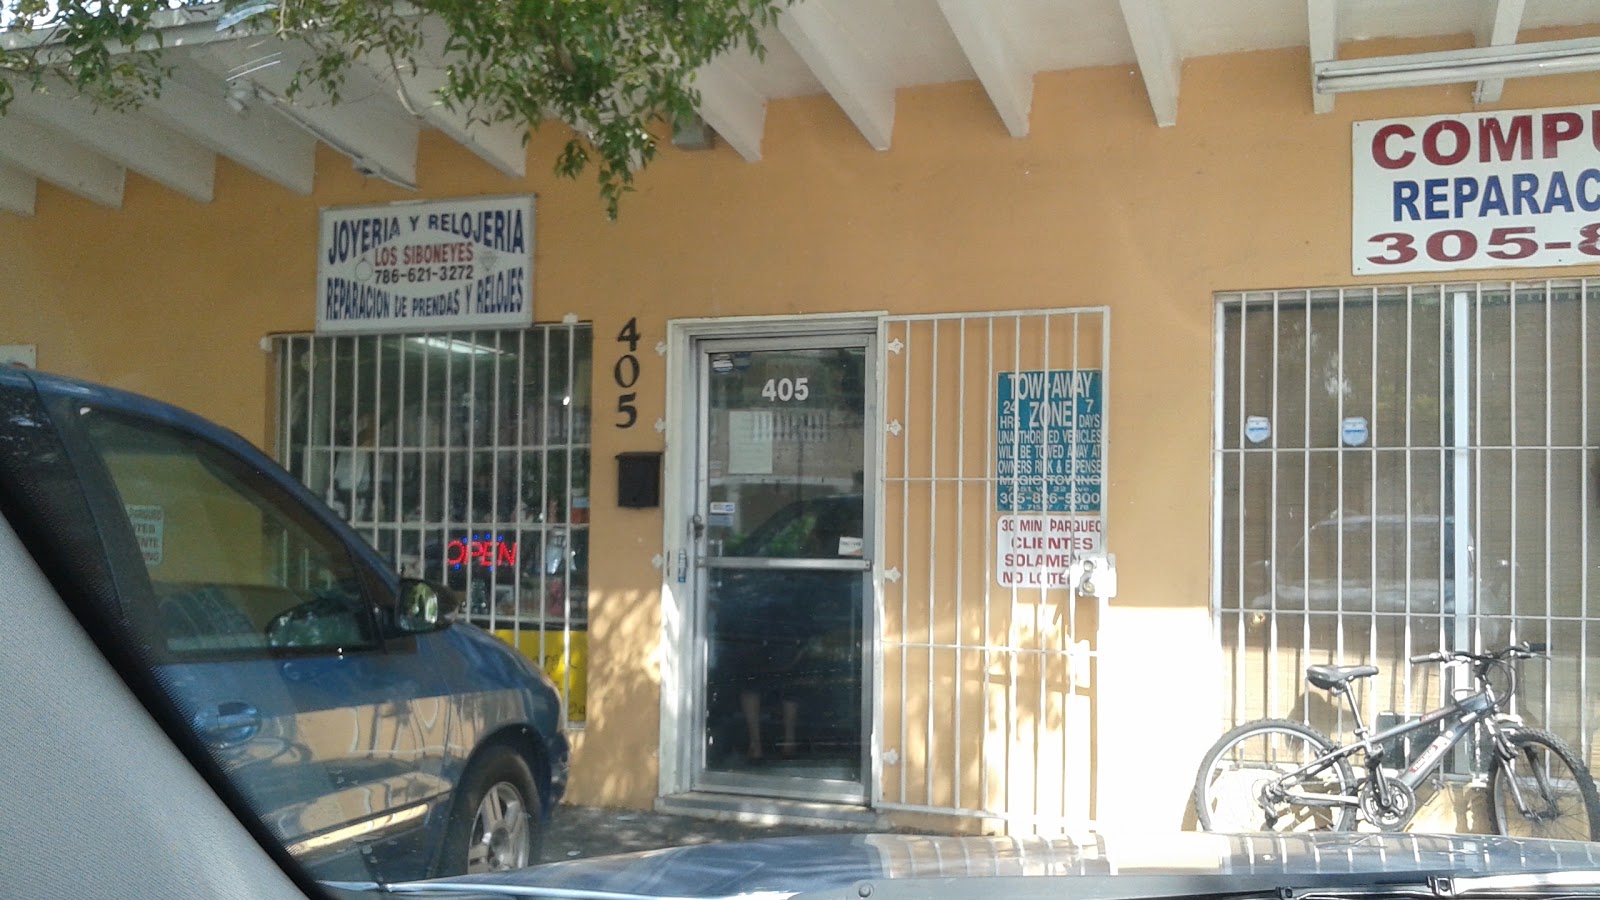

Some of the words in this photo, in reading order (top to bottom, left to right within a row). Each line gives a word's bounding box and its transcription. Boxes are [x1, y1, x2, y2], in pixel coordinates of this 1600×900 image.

[1371, 110, 1600, 169] COMP
[328, 217, 400, 264] JOYERIA
[409, 215, 419, 231] Y
[428, 210, 524, 254] RELOJERIA
[375, 247, 397, 266] LOS
[404, 242, 474, 265] SIBONEYES
[375, 265, 474, 284] 786-621-3272
[326, 277, 390, 320] REPARACION
[395, 297, 407, 317] DE
[412, 289, 460, 316] PRENDAS
[465, 283, 473, 314] Y
[476, 267, 524, 314] RELOJES
[762, 378, 809, 401] 405
[1029, 400, 1073, 427] ZONE
[1085, 399, 1094, 413] 7
[1079, 414, 1101, 428] DAYS
[998, 429, 1060, 444] UNATHORIED
[998, 445, 1016, 459] WIL
[1019, 445, 1031, 459] BE
[1091, 444, 1102, 458] AT
[1035, 459, 1053, 473] RIK
[1056, 459, 1062, 473] &
[1065, 459, 1101, 473] EPENSE
[1000, 492, 1100, 504] 305-86-5300
[1019, 519, 1042, 532] MIN
[1011, 537, 1093, 550] CLIENTES
[446, 540, 518, 567] OPEN
[1003, 571, 1023, 584] NO
